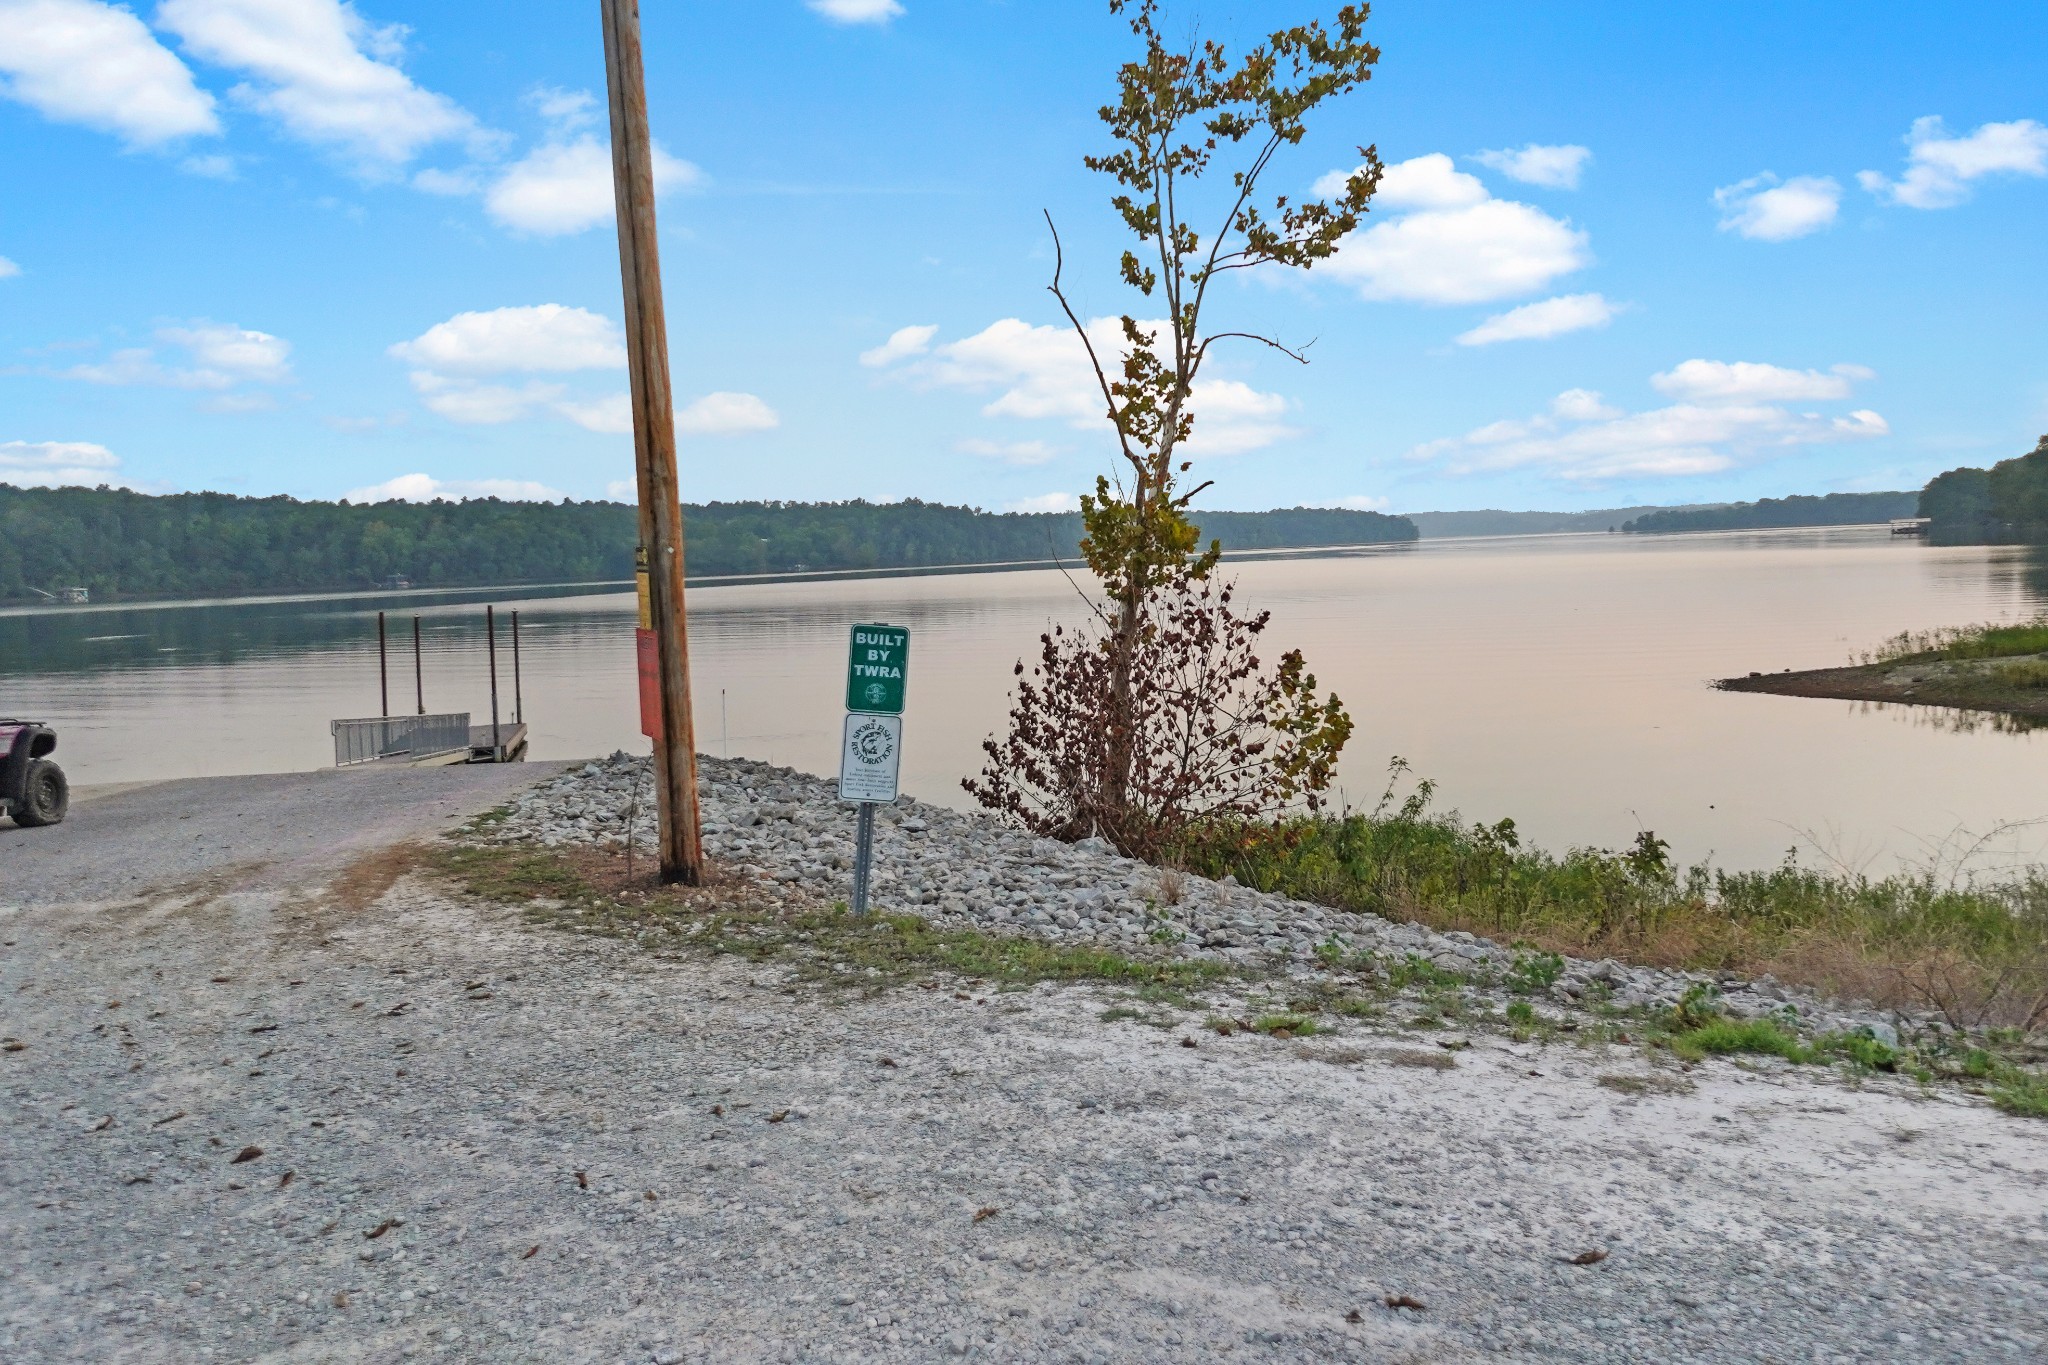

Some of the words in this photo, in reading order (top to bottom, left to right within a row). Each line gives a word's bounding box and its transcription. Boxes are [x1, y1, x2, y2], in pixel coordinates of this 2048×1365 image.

[856, 632, 905, 647] BUILT
[867, 649, 891, 662] BY
[853, 664, 902, 679] TWRA
[852, 723, 876, 740] SPORT
[877, 724, 893, 741] FISH
[851, 741, 893, 764] RESTORATION
